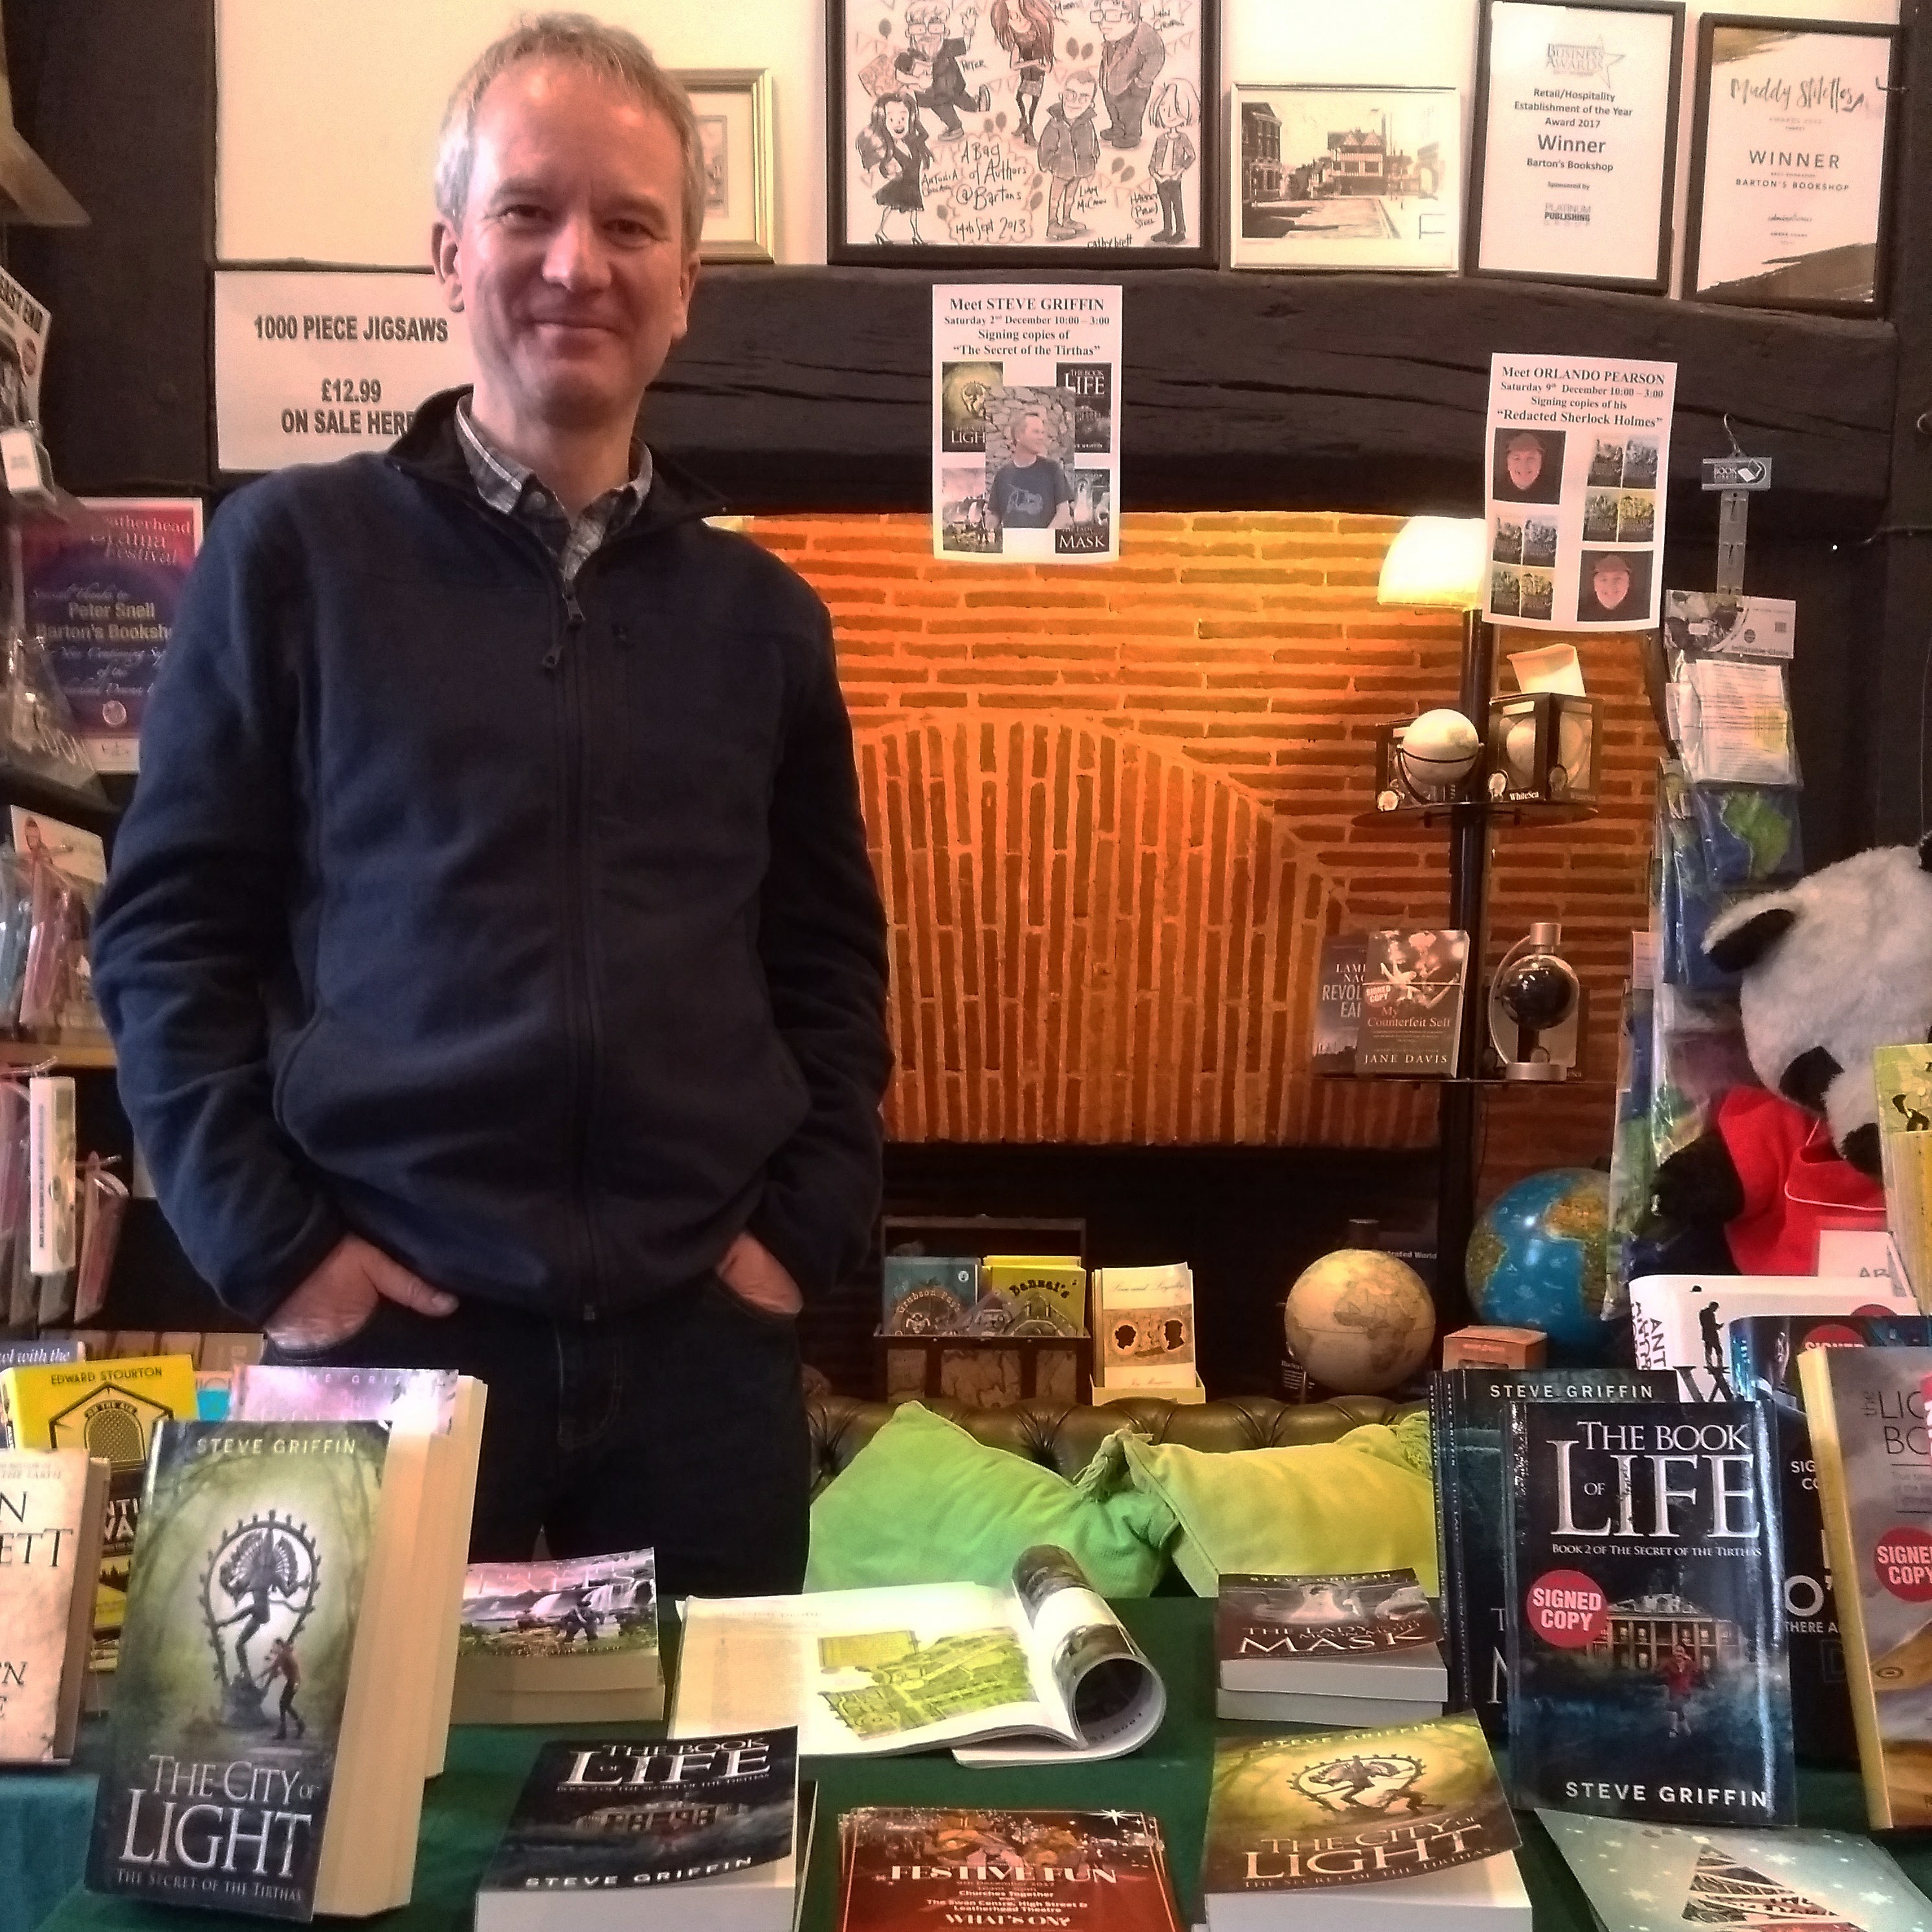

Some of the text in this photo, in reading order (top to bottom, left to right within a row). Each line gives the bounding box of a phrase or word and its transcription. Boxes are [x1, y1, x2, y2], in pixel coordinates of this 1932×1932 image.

[1533, 88, 1616, 102] Retail/Hospitality
[1731, 77, 1792, 111] Muddy
[1515, 101, 1633, 117] Establishment of the Year
[1545, 117, 1601, 128] Award 2017
[1538, 134, 1606, 153] Winner
[961, 140, 1001, 168] A Bag
[1749, 150, 1840, 169] WINNER
[969, 158, 1027, 186] of Authors
[1526, 158, 1614, 173] Barton's Bookshop
[1736, 179, 1850, 192] BARTON'S BOOKSHOP
[1544, 212, 1591, 221] PUBLISHING
[999, 217, 1027, 239] 2013
[950, 298, 1105, 311] Meet STEVE GRIFFIN
[254, 315, 449, 342] 1000 PIECE JIGSAWS
[944, 316, 986, 326] Saturday
[1005, 316, 1052, 325] December
[1054, 316, 1080, 325] 10:00
[1089, 316, 1111, 325] 3:00
[978, 329, 1070, 342] Signing copies of
[984, 345, 1017, 355] Secret
[1021, 345, 1033, 355] of
[1034, 345, 1052, 355] the
[1065, 372, 1106, 395] LIFE
[1502, 366, 1665, 385] Meet ORLANDO PEARSON
[320, 377, 383, 403] £12.99
[1500, 382, 1542, 392] Saturday
[1562, 384, 1606, 395] December
[1610, 387, 1634, 397] 10:00
[1644, 390, 1663, 399] 3:00
[1531, 396, 1627, 410] Signing copies of his
[280, 408, 362, 435] ON SALE
[1560, 412, 1610, 425] Sherlock
[1059, 535, 1106, 549] MASK
[69, 601, 155, 619] Peter Snell
[1366, 984, 1392, 997] SIGNED
[1369, 992, 1389, 1003] COPY
[1367, 1017, 1451, 1028] Counterfeit Self
[1364, 1054, 1448, 1065] JANE DAVIS
[17, 1348, 70, 1362] with the
[51, 1367, 163, 1384] EDWARD STOURTON
[1490, 1384, 1653, 1399] STEVE GRIFFIN
[1577, 1421, 1751, 1452] THE BOOK
[196, 1438, 356, 1455] STEVE GRIFFIN
[1546, 1439, 1760, 1538] LIFE
[1584, 1482, 1606, 1496] OF
[1552, 1543, 1583, 1554] BOOK
[1584, 1544, 1592, 1554] 2
[1593, 1545, 1607, 1555] OF
[1608, 1545, 1632, 1555] THE
[1634, 1546, 1672, 1556] SECRET
[1674, 1547, 1689, 1556] OF
[1692, 1547, 1713, 1556] THE
[1876, 1546, 1932, 1564] SIGNE
[1532, 1587, 1602, 1612] SIGNED
[1540, 1608, 1593, 1632] COPY
[1238, 1627, 1427, 1653] MASK
[603, 1738, 770, 1757] THE BOOK
[557, 1744, 772, 1787] LIFE
[150, 1754, 322, 1805] THE CITY OF
[1566, 1781, 1768, 1808] STEVE GRIFFIN
[118, 1788, 313, 1877] LIGHT
[1260, 1836, 1344, 1854] THE
[1355, 1817, 1452, 1847] CITY
[1242, 1823, 1483, 1880] LIGHT
[117, 1868, 142, 1883] THE
[526, 1856, 753, 1887] STEVE GRIFFIN
[891, 1865, 1118, 1884] FESTIVE FUN
[945, 1913, 1025, 1925] WHAT'S
